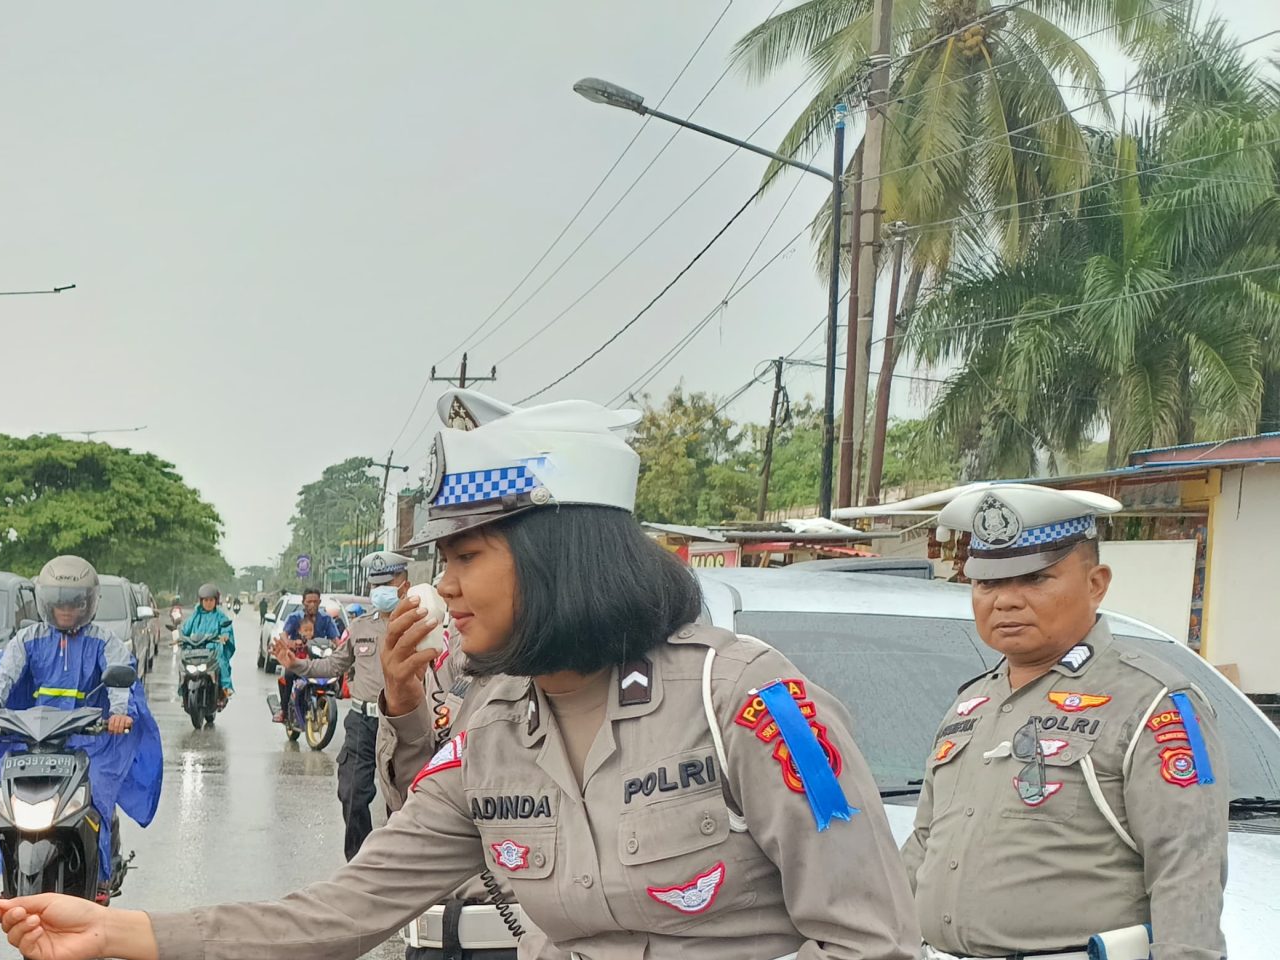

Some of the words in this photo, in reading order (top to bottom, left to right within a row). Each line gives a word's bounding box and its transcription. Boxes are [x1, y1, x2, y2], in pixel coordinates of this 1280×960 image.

[743, 682, 800, 721] POA
[624, 755, 716, 804] POLRI
[471, 795, 551, 820] ADINDA
